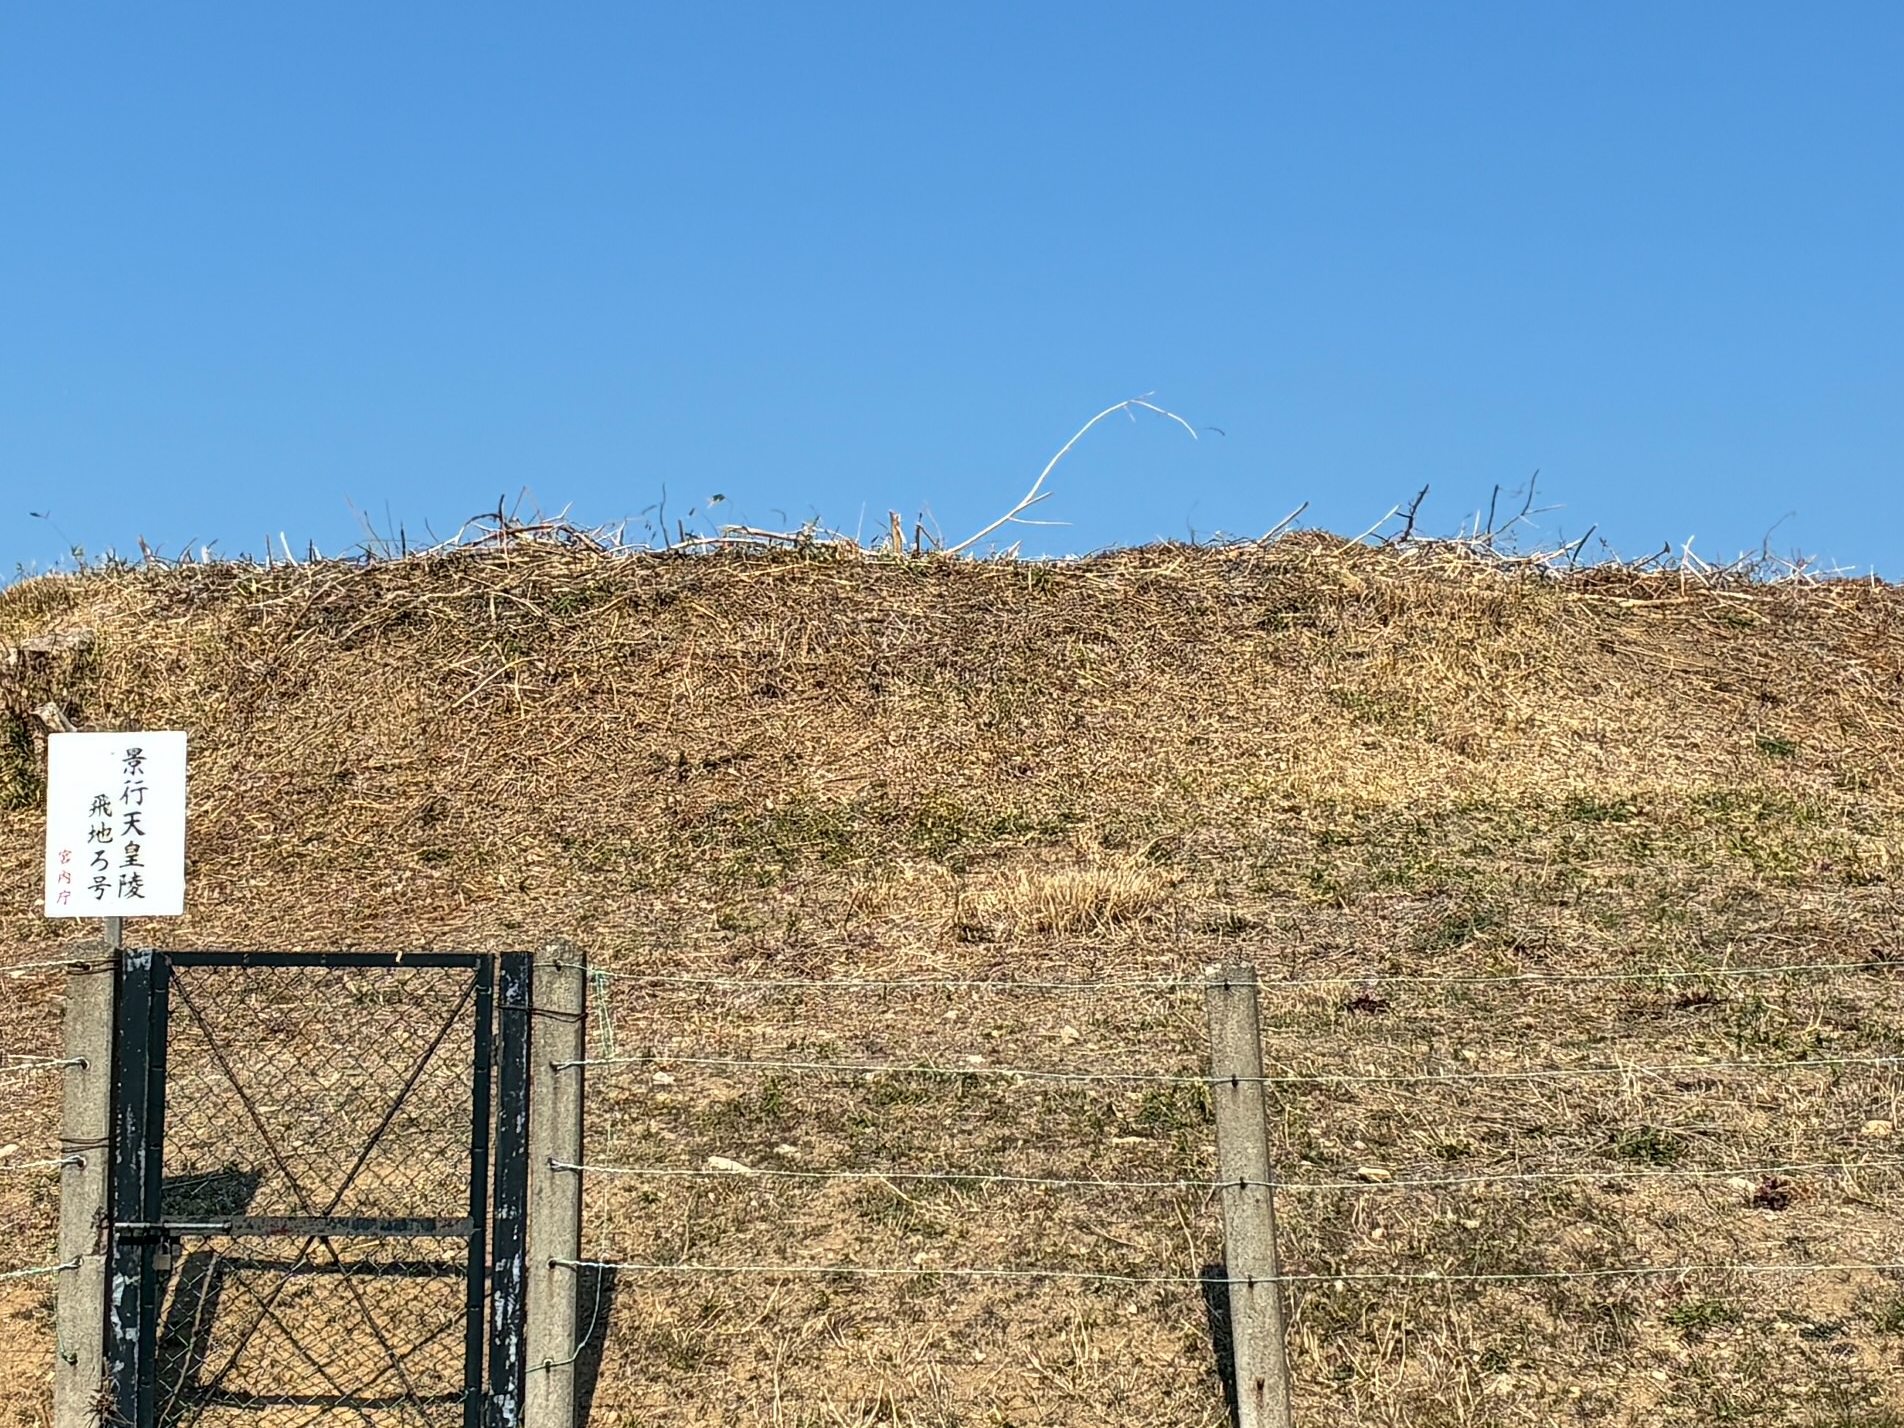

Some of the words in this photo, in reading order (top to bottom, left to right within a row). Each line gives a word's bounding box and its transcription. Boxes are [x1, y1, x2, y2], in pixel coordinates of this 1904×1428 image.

[88, 794, 113, 900] 飛地ろ号
[118, 748, 148, 899] 景行天皇陵
[57, 850, 72, 905] 宮内庁
